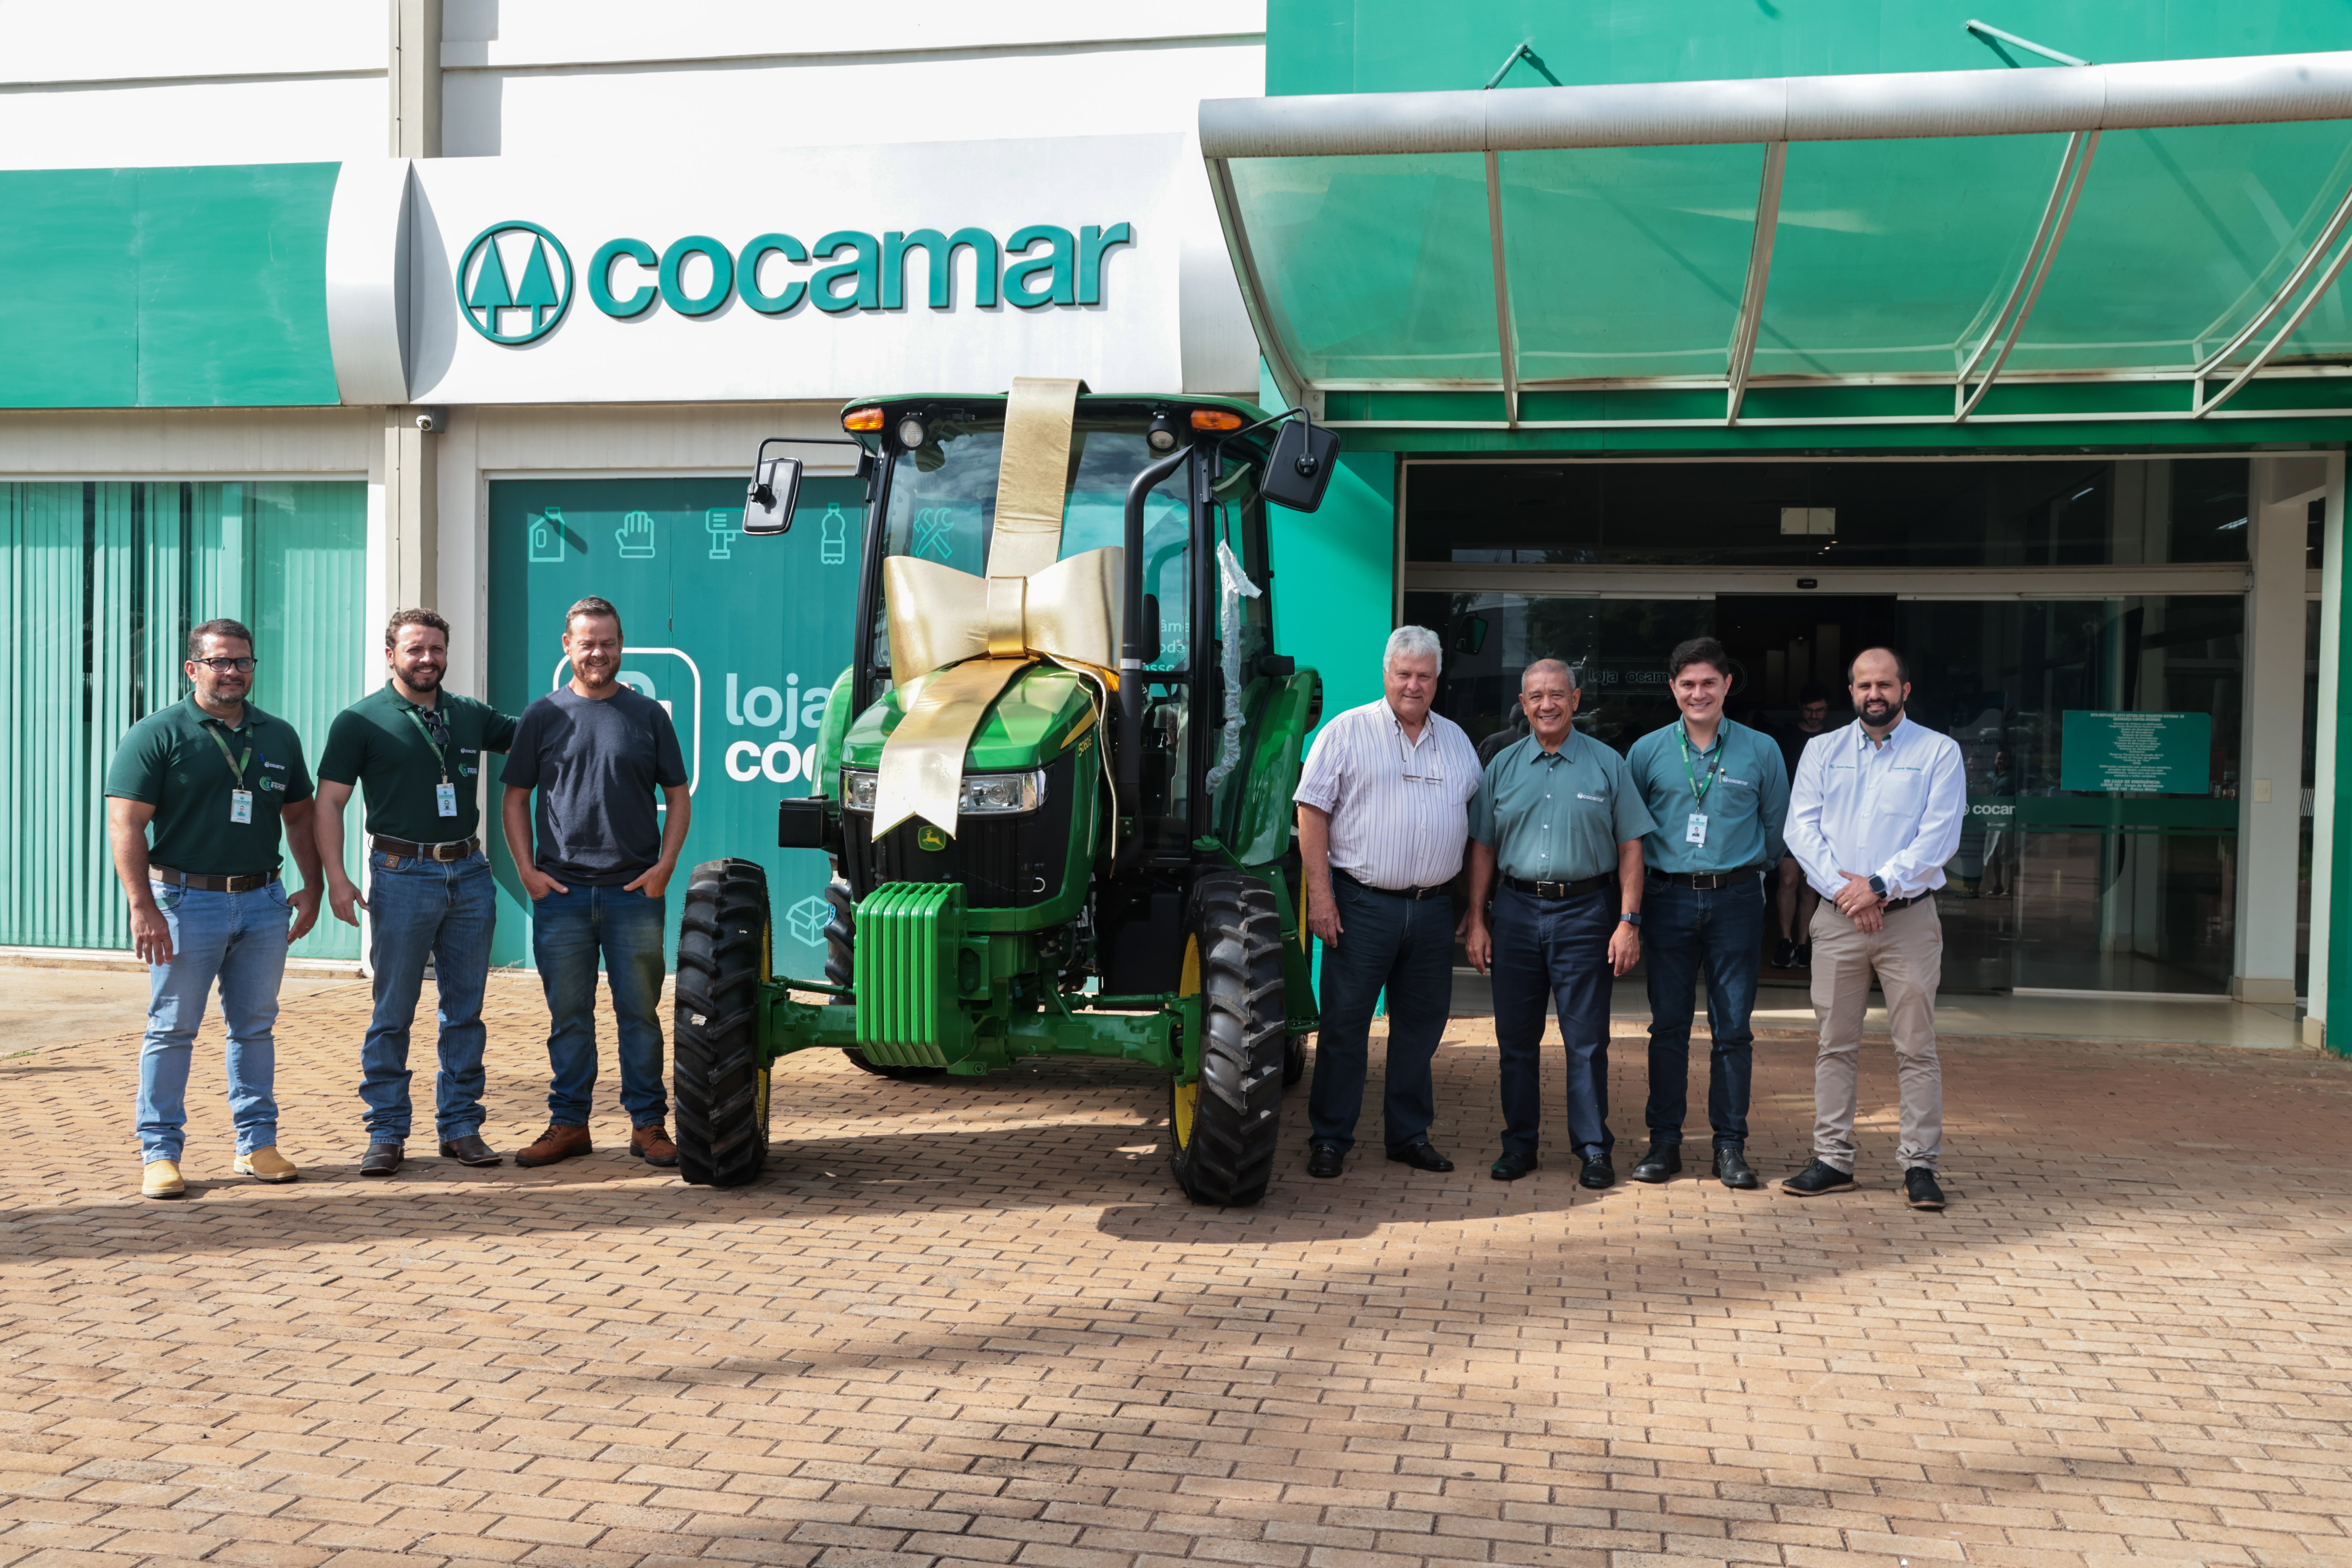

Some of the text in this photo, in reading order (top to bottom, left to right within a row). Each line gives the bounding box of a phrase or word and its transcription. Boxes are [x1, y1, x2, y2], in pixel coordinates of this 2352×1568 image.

[588, 222, 1130, 318] cocamar
[1589, 668, 1671, 685] loja ocam
[1079, 734, 1091, 757] 5060E
[1583, 794, 1604, 802] cocamar
